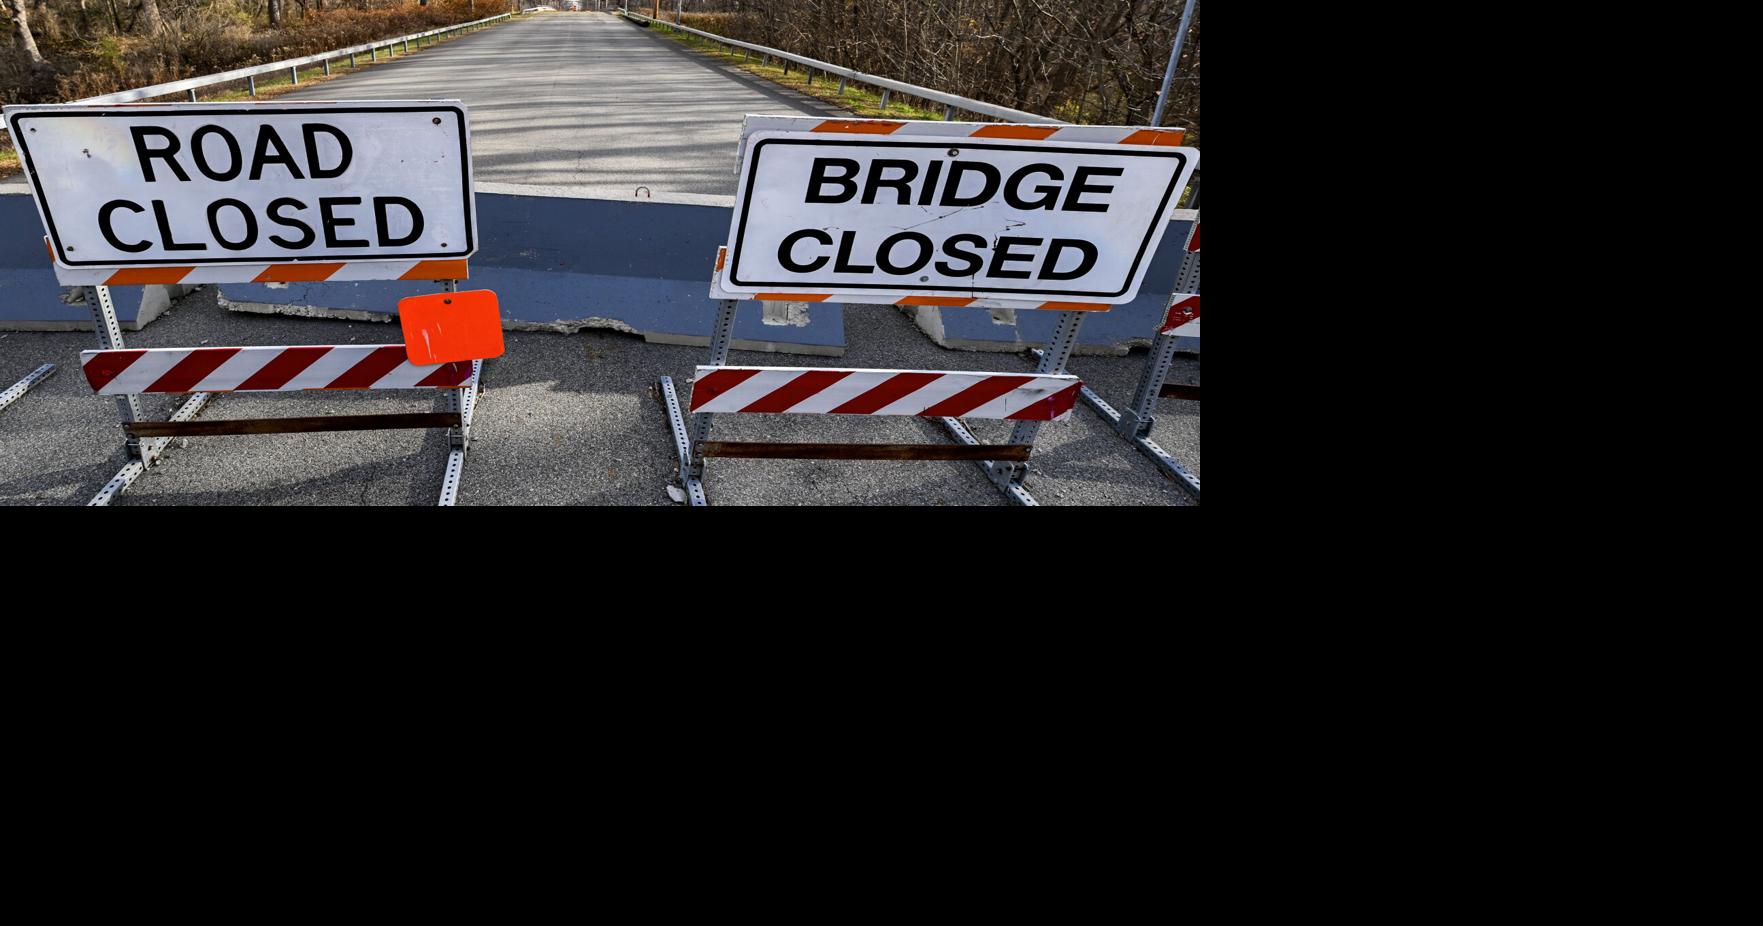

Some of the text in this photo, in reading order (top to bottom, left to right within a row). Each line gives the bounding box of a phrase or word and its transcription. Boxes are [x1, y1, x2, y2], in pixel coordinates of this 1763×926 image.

[130, 123, 353, 182] ROAD
[805, 158, 1124, 212] BRIDGE
[98, 197, 424, 253] CLOSED
[778, 229, 1098, 281] CLOSED
